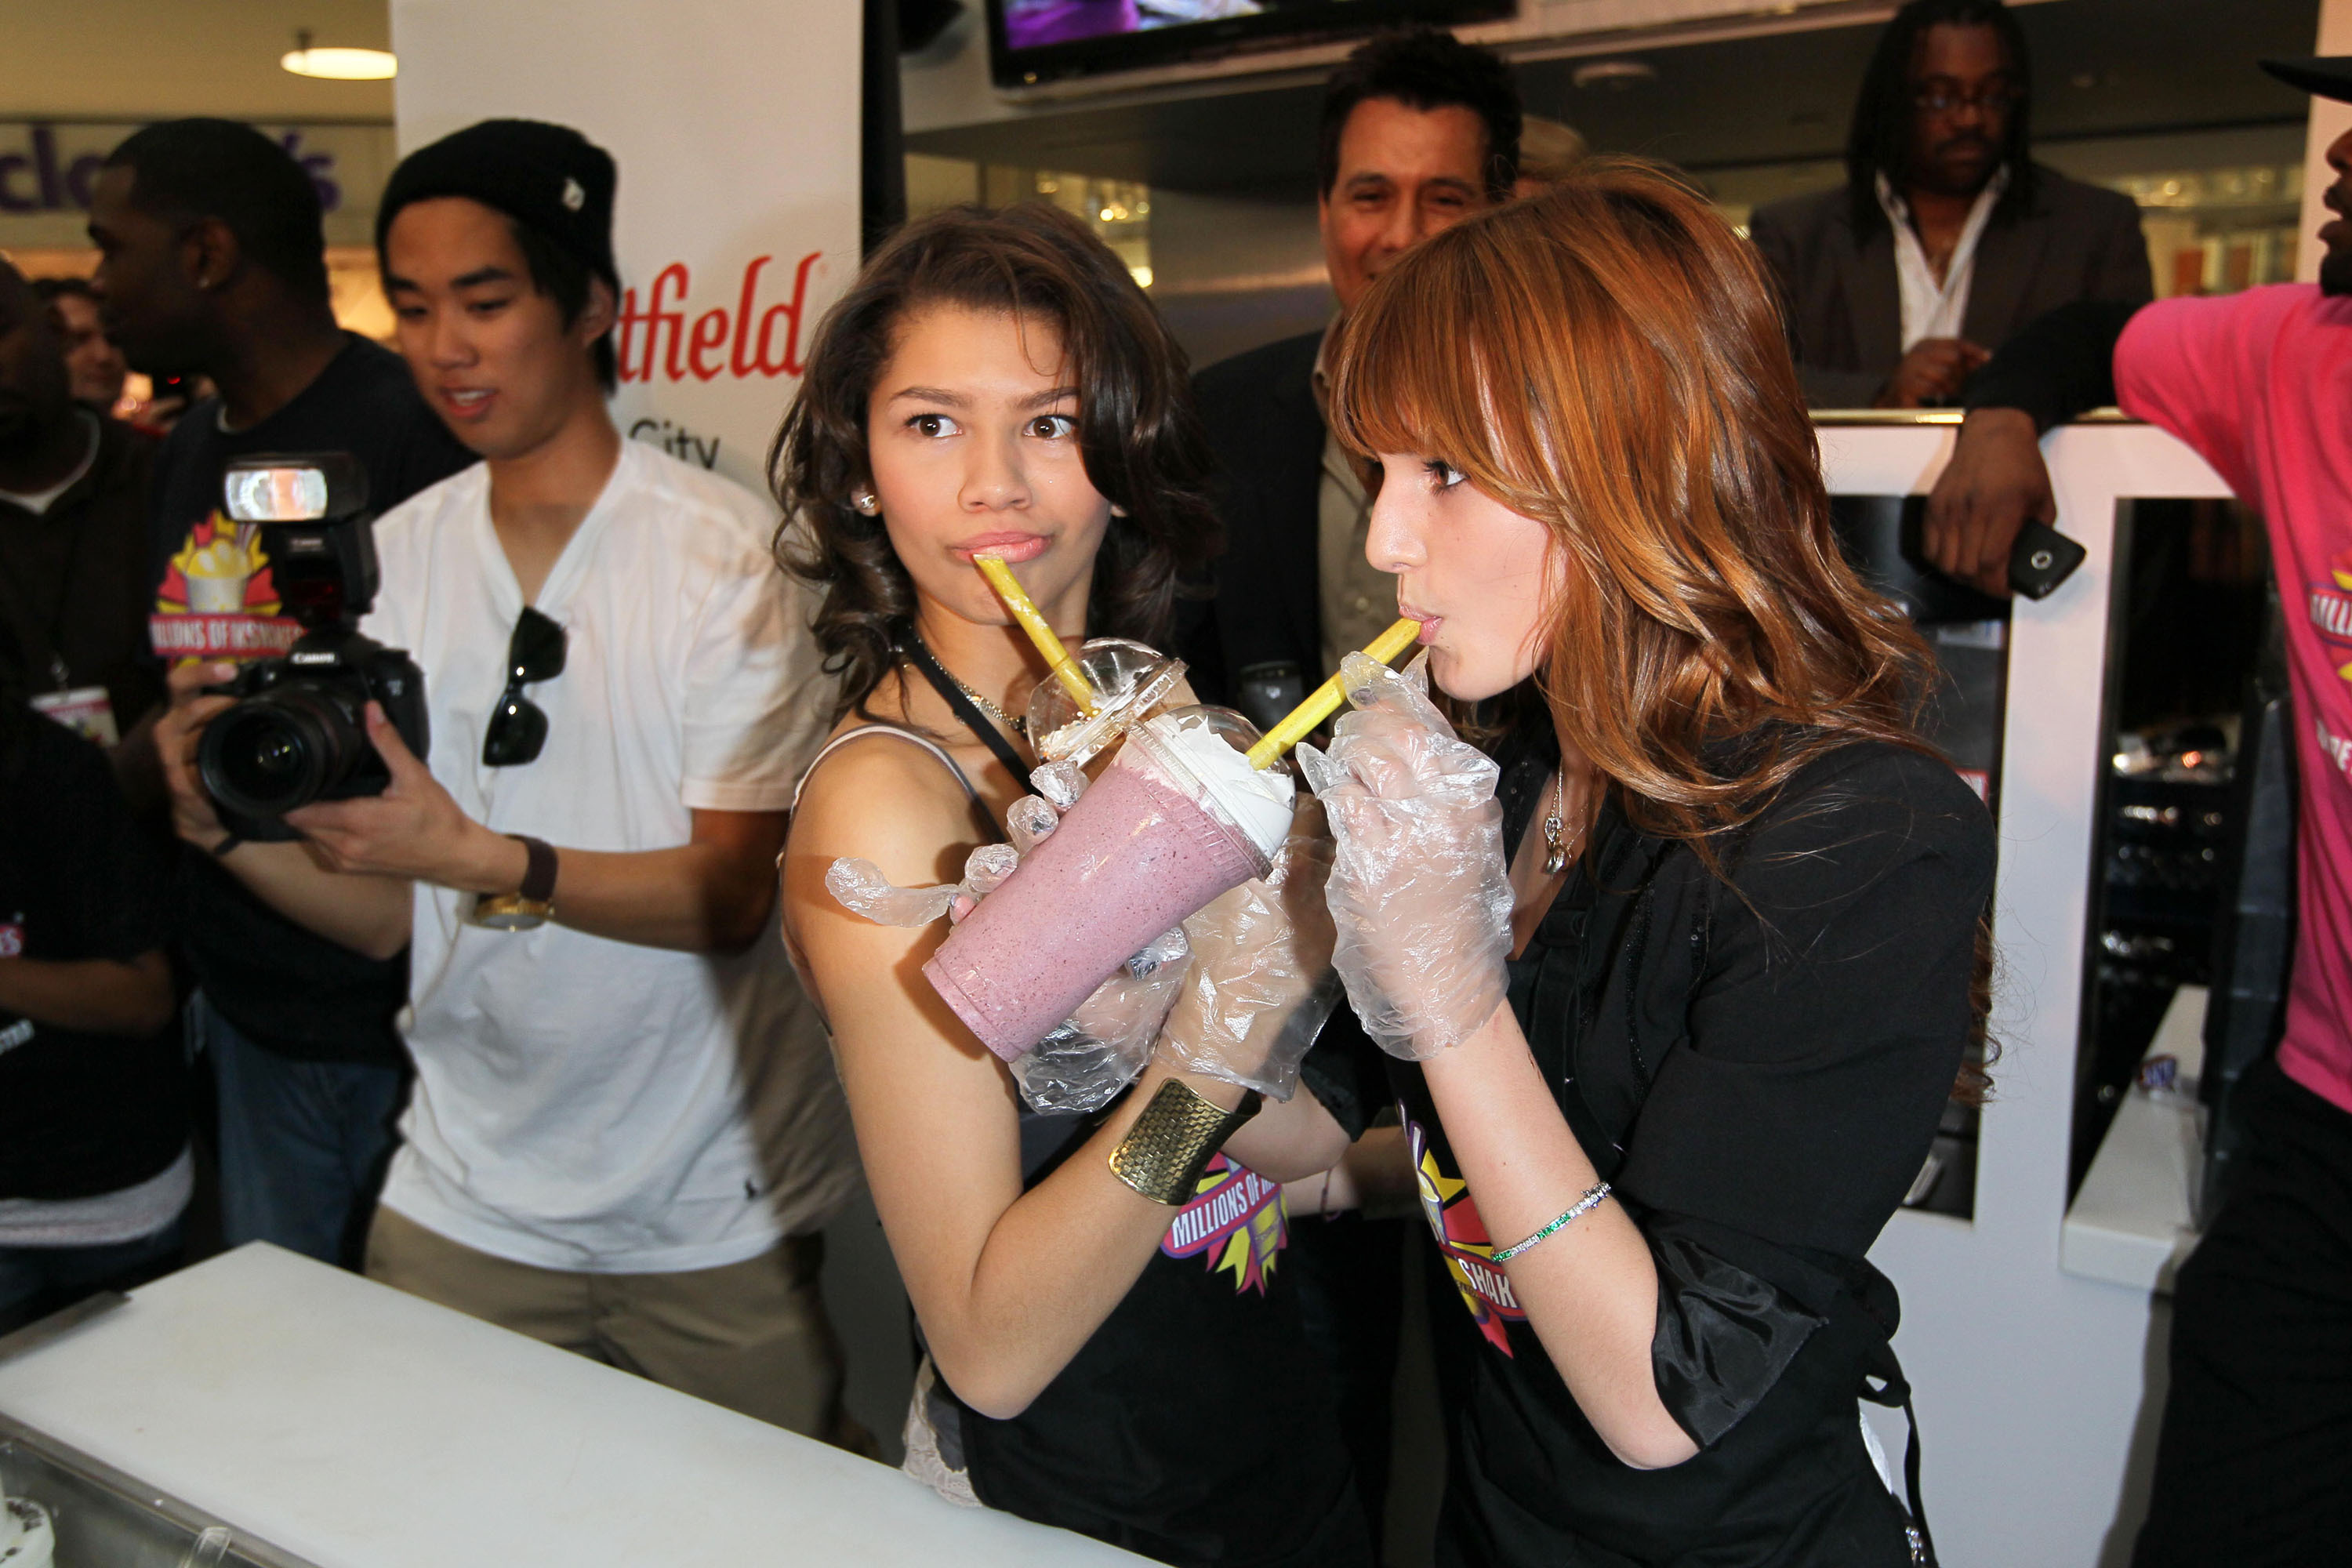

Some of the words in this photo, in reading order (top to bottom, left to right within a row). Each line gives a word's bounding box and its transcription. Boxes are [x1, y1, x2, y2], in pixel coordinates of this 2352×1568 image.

[619, 252, 822, 383] tfield
[1172, 1181, 1248, 1248] MILLIONS
[1245, 1172, 1260, 1207] OF
[1457, 1258, 1518, 1308] SHAK
